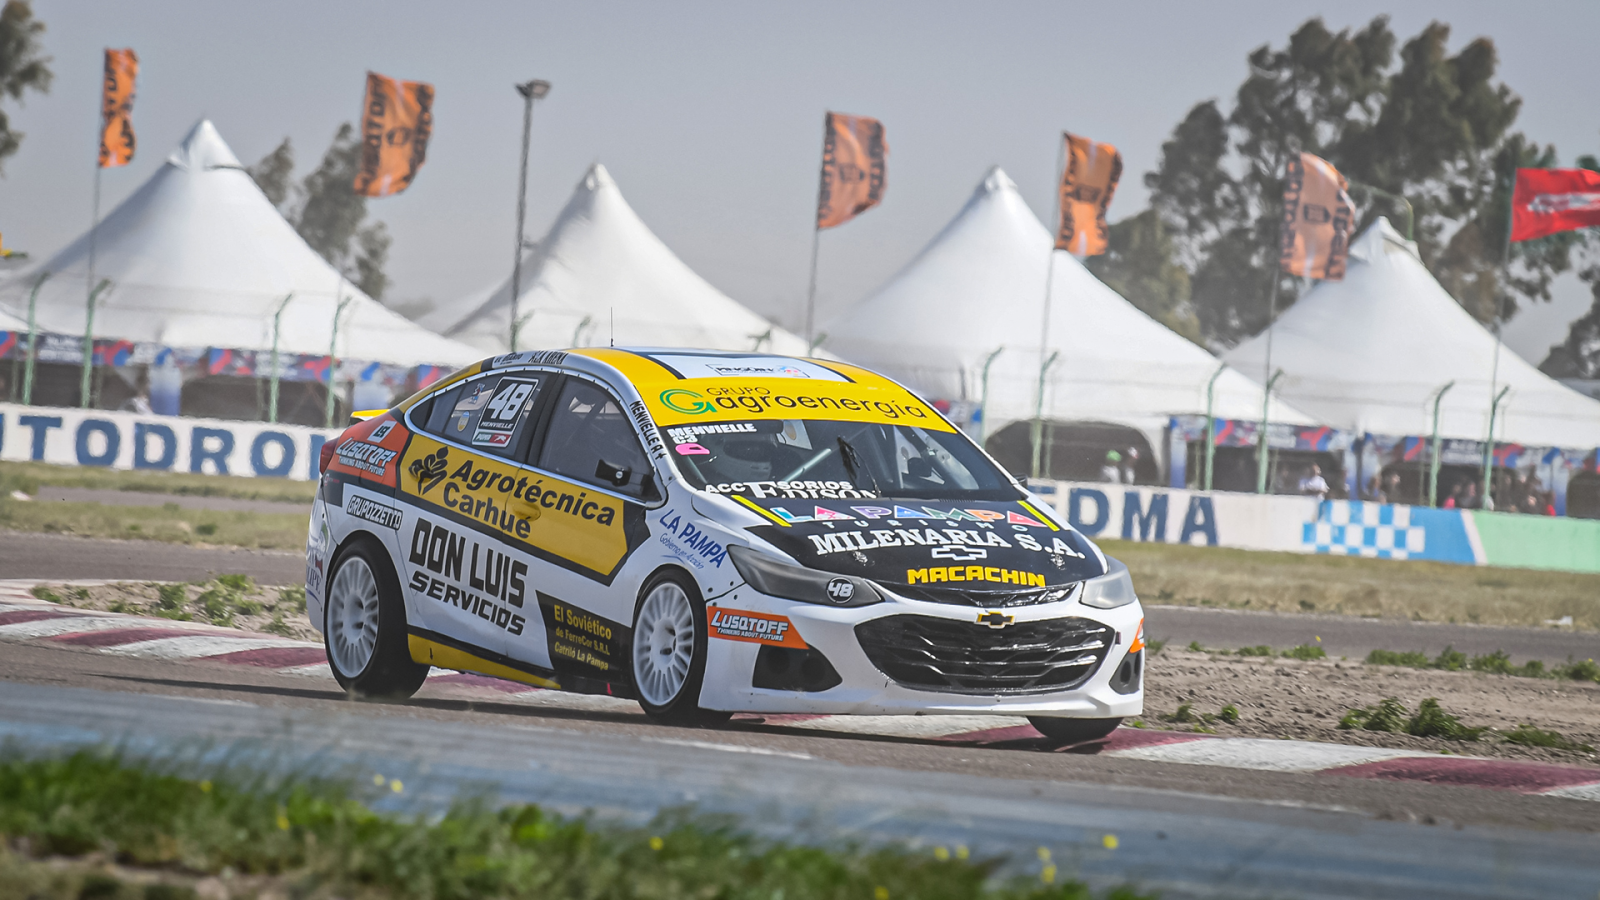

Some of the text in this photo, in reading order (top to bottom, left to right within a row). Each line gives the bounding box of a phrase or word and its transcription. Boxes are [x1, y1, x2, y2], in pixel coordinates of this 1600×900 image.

[488, 383, 533, 420] 48
[706, 386, 771, 396] GRUPO
[480, 421, 514, 429] MENVIELLE
[630, 400, 660, 447] MENVIELLE
[667, 423, 757, 437] MENVIELLE
[0, 412, 325, 480] TODRO
[673, 434, 698, 444] C3
[449, 460, 615, 527] Agrotécnica
[443, 482, 531, 539] Carhué
[770, 505, 1049, 528] LA PAMPA
[660, 509, 727, 568] LA PAMPA
[808, 527, 1088, 559] MILENARIA S.A.
[409, 517, 528, 609] DON LUIS
[907, 564, 1047, 588] MACACHIN
[827, 583, 854, 598] 48
[409, 570, 526, 636] SERVICIOS
[554, 604, 612, 640] El Soviético
[556, 627, 564, 638] de
[711, 611, 788, 635] LUSQTOFF
[717, 627, 740, 636] THINKING
[760, 634, 784, 642] FUTURE
[577, 649, 586, 662] La
[586, 653, 609, 671] Pampa
